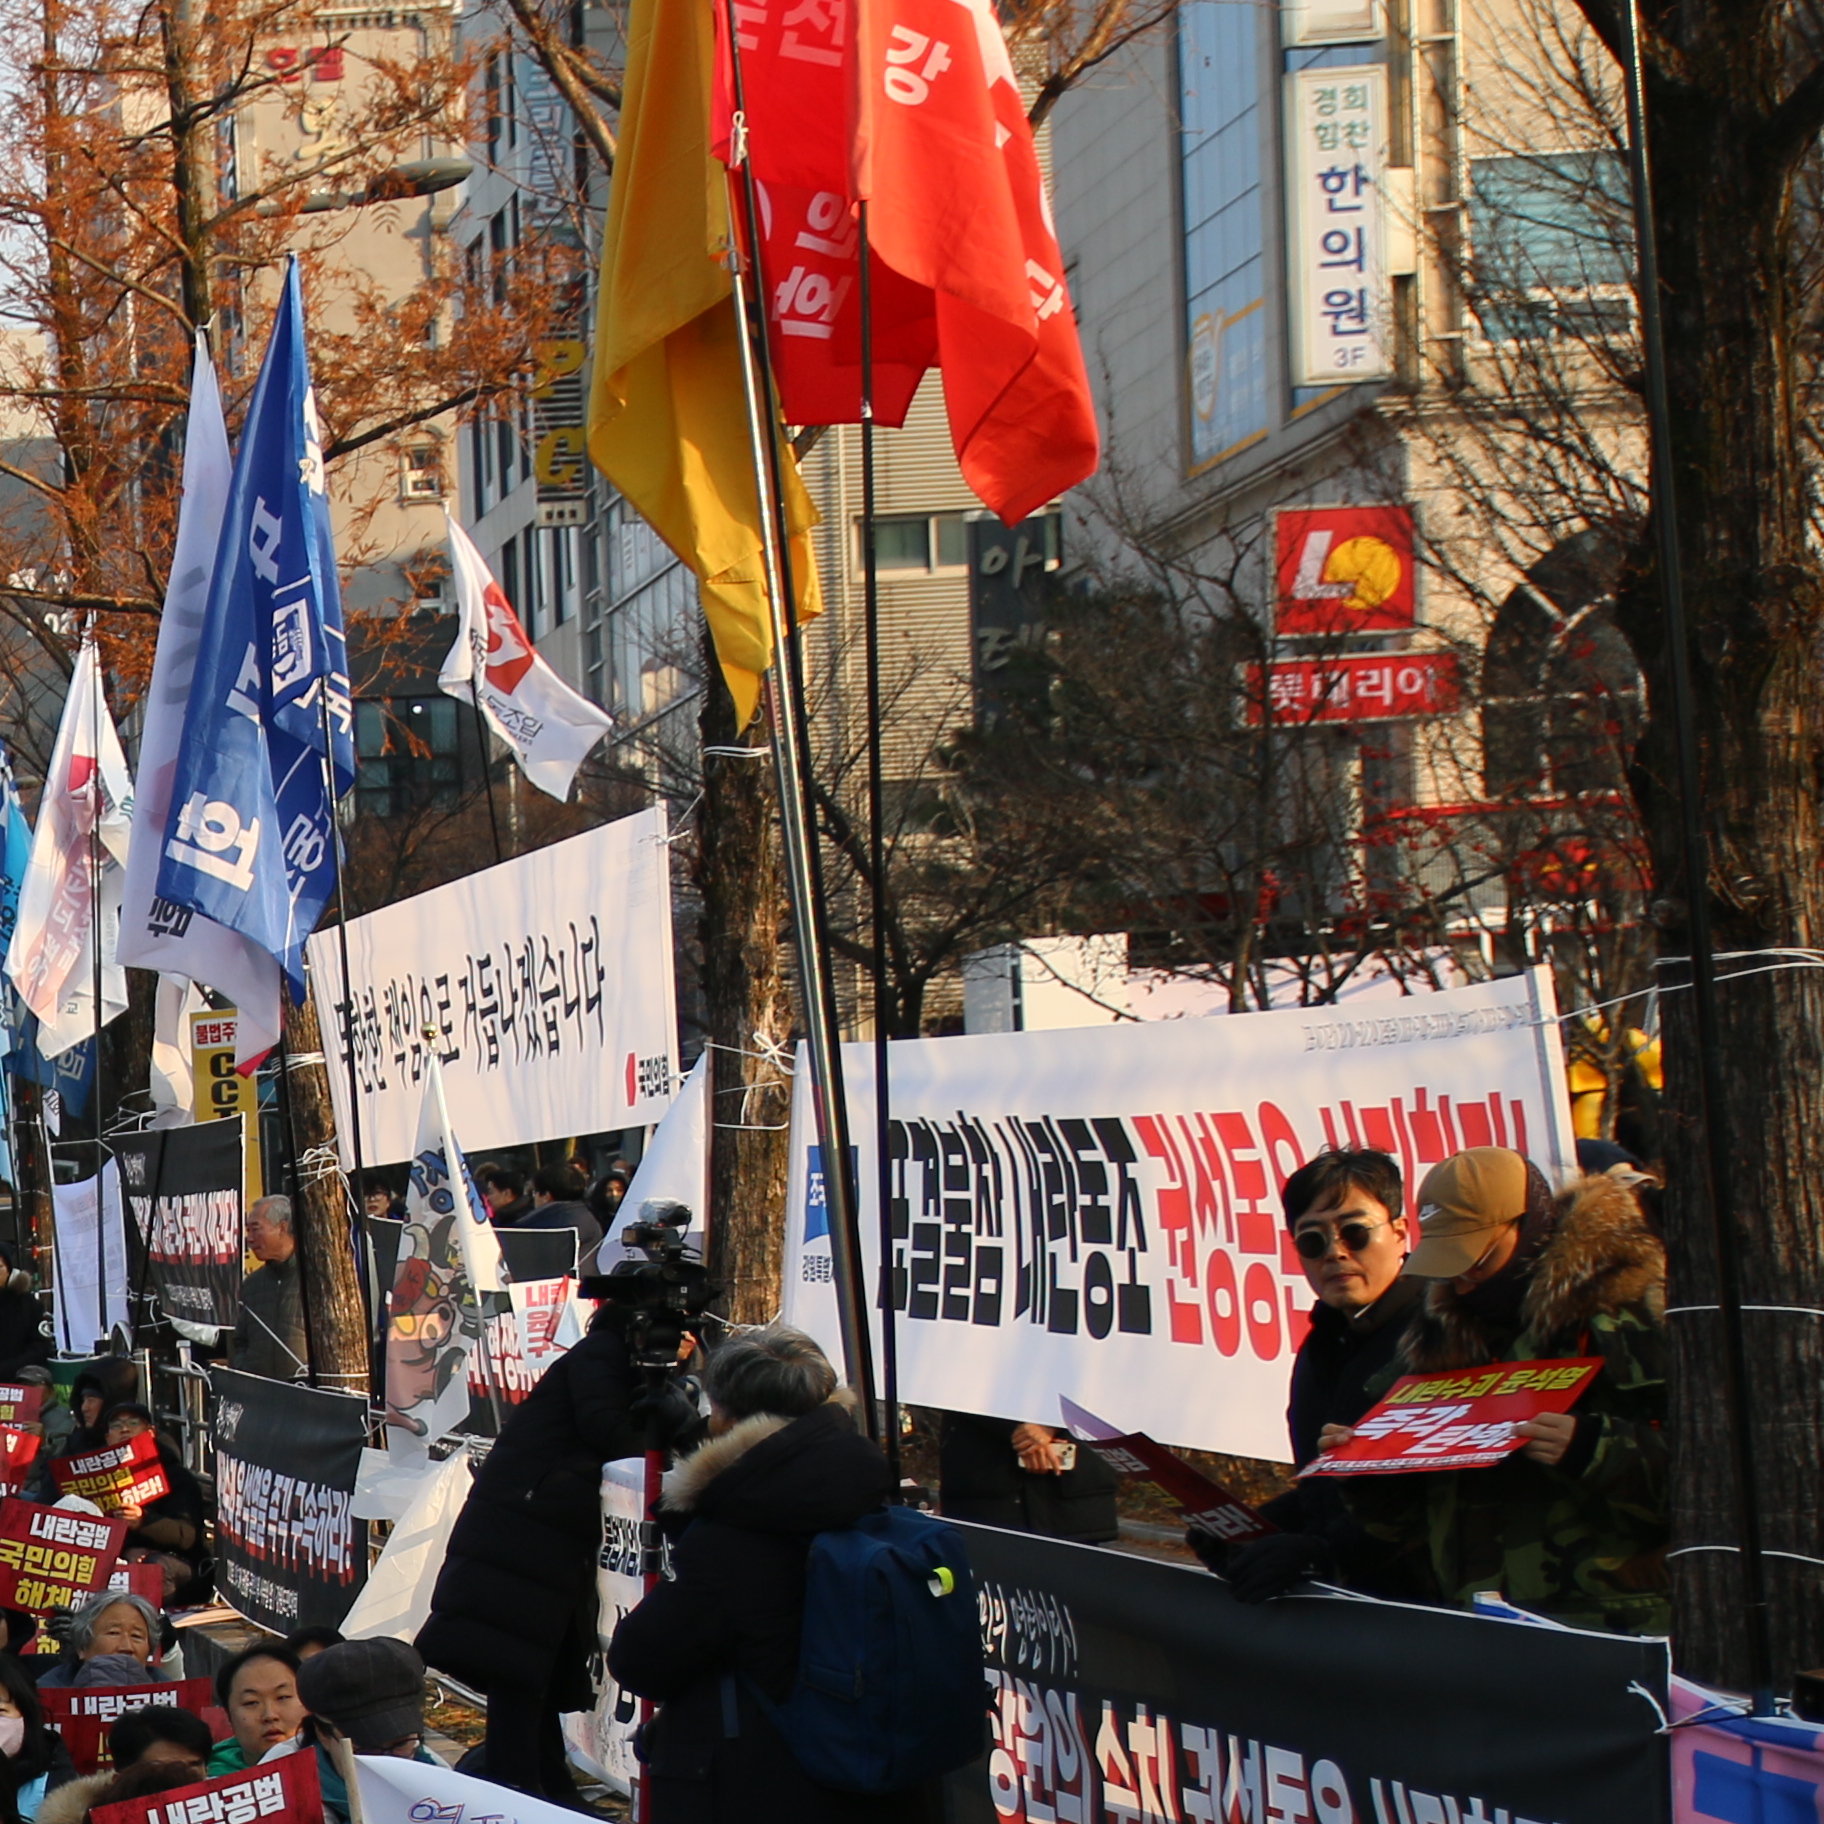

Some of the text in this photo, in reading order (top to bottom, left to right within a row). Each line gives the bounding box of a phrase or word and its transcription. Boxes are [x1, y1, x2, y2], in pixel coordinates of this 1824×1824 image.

[1317, 162, 1369, 337] 한의원
[1332, 346, 1366, 368] 3F
[459, 915, 605, 1074] 거듭나겠습니다
[993, 1115, 1152, 1340] 내란동조
[1384, 1365, 1593, 1404] 내란수괴 윤석열
[1353, 1403, 1473, 1440] 즉각
[69, 1446, 134, 1474] 내란공범
[61, 1468, 134, 1498] 국민의힘
[30, 1513, 110, 1550] 내란공범
